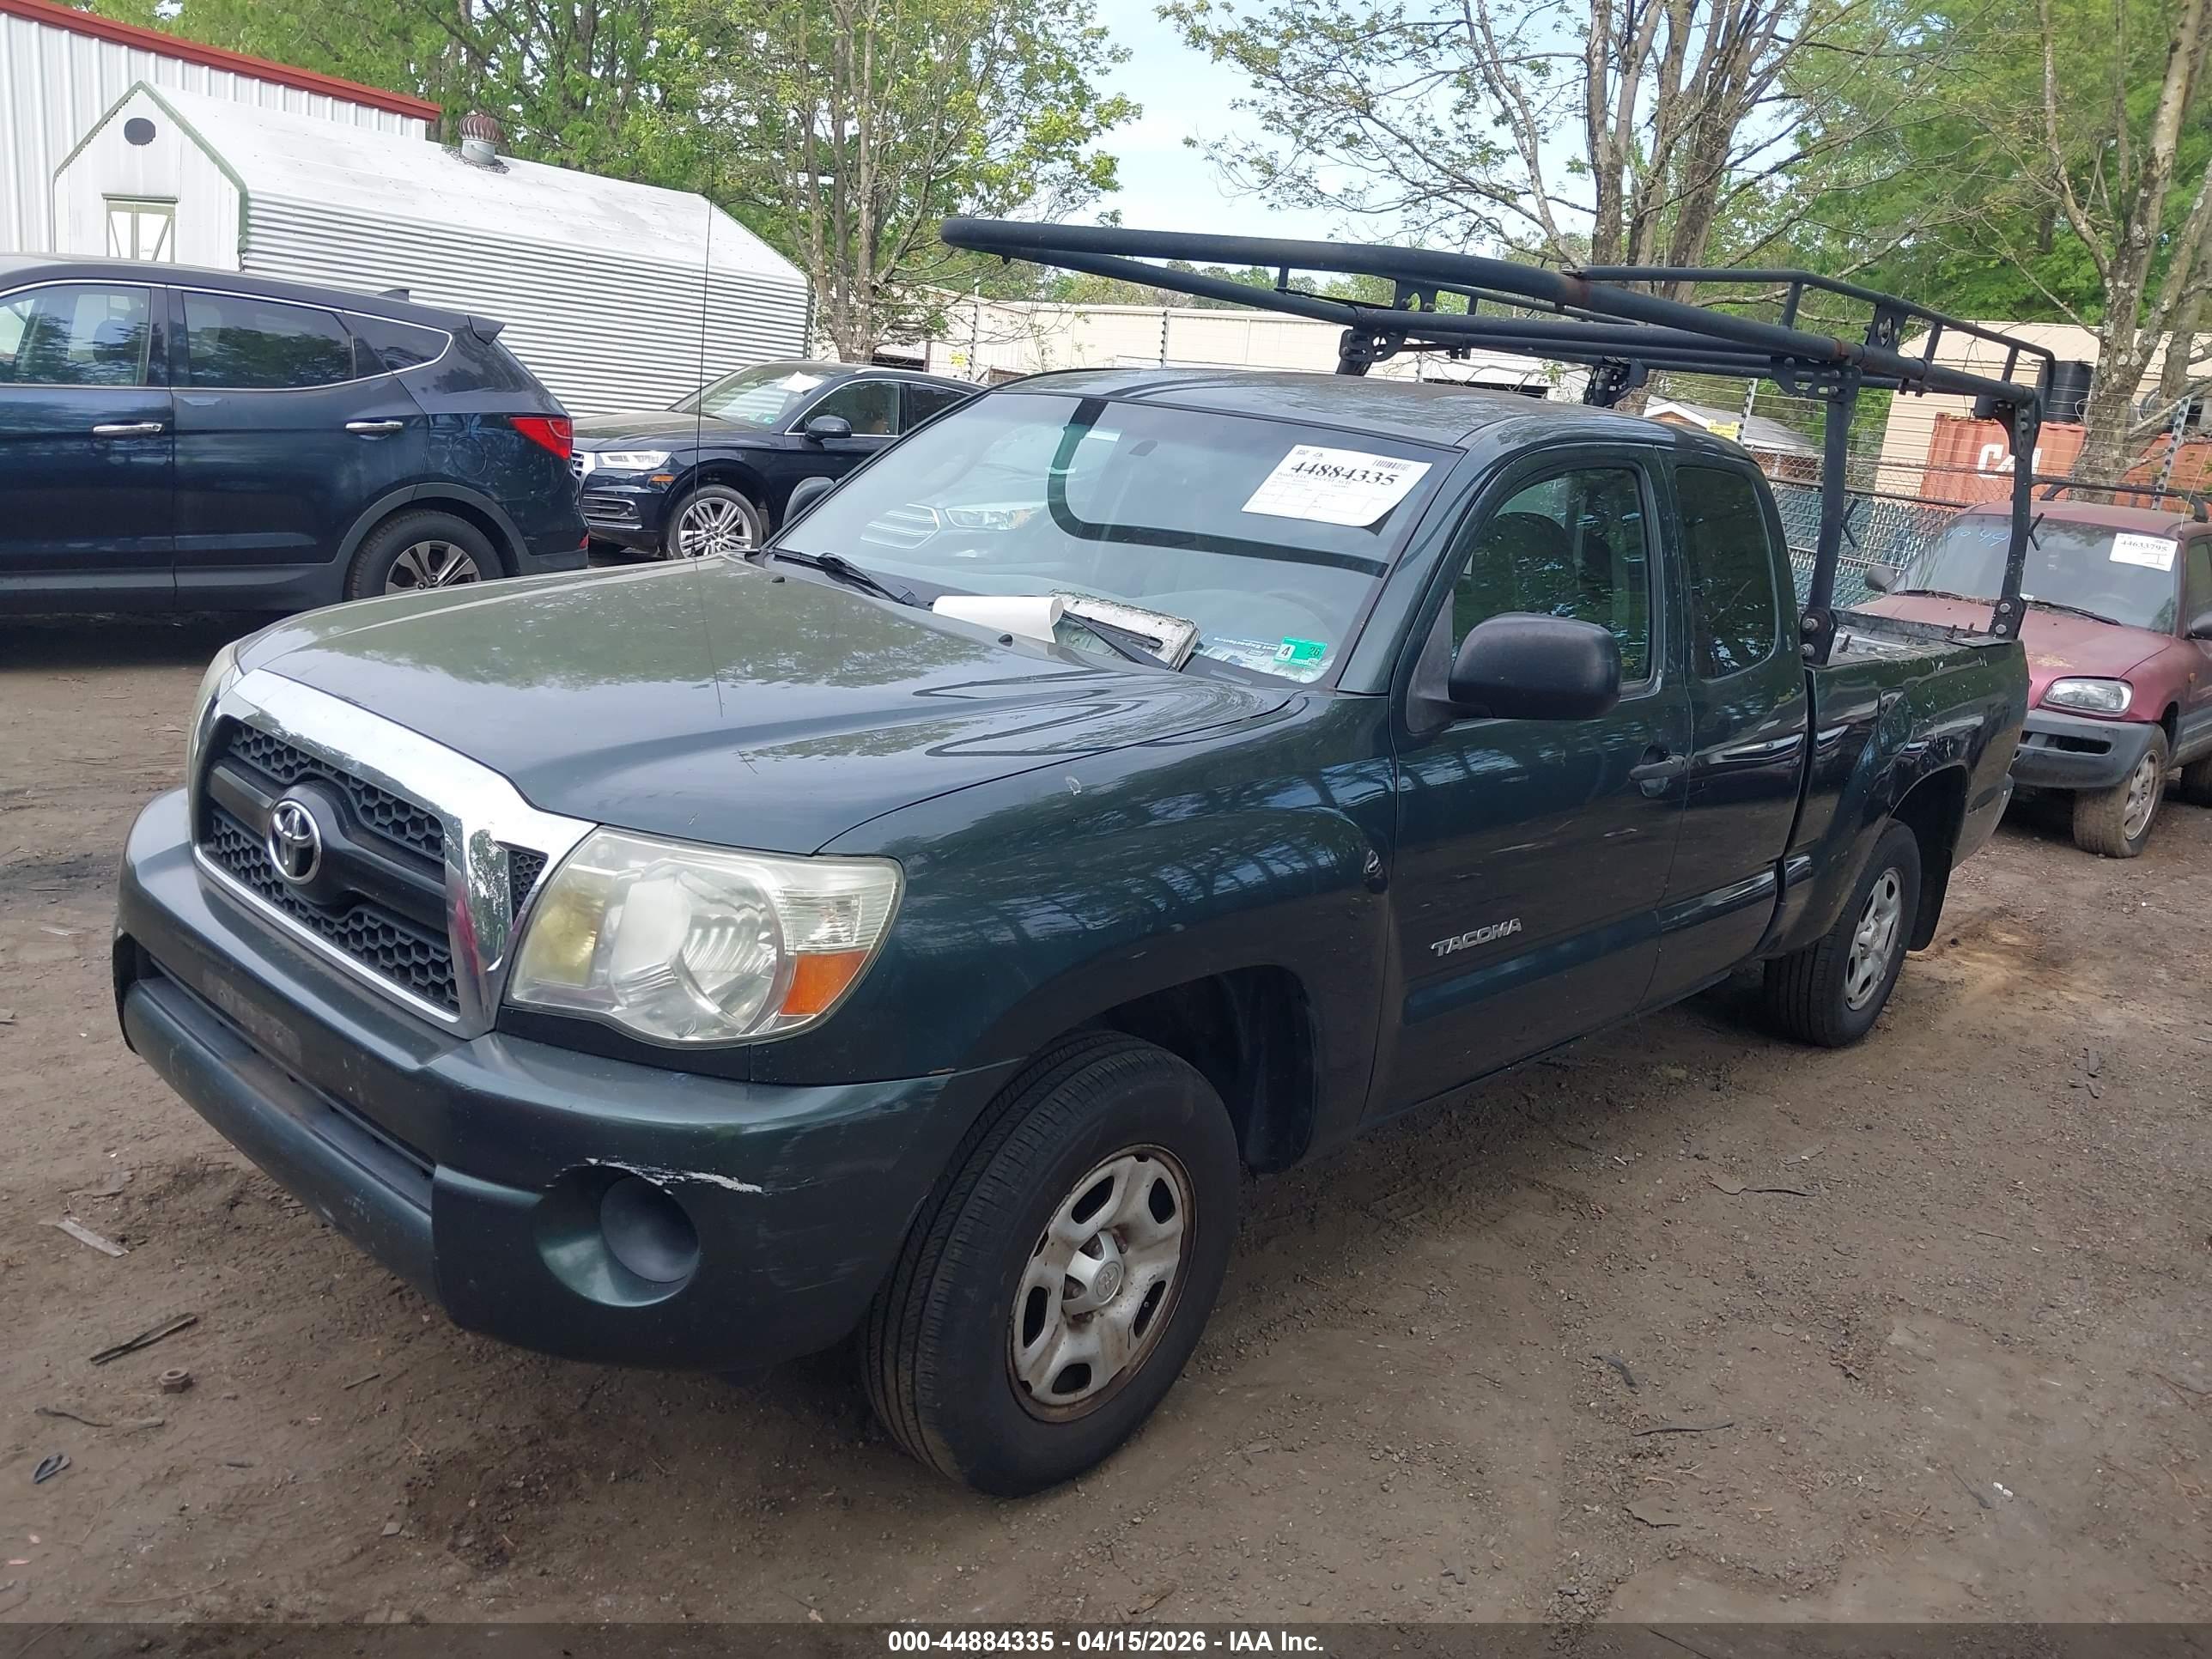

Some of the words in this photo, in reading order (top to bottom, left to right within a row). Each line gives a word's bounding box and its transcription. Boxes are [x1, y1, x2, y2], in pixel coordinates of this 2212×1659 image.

[1291, 461, 1401, 486] 44884335
[2120, 540, 2169, 552] 44633795
[1281, 647, 1291, 657] 4
[1308, 646, 1321, 657] 26
[1430, 918, 1522, 957] TACOMA
